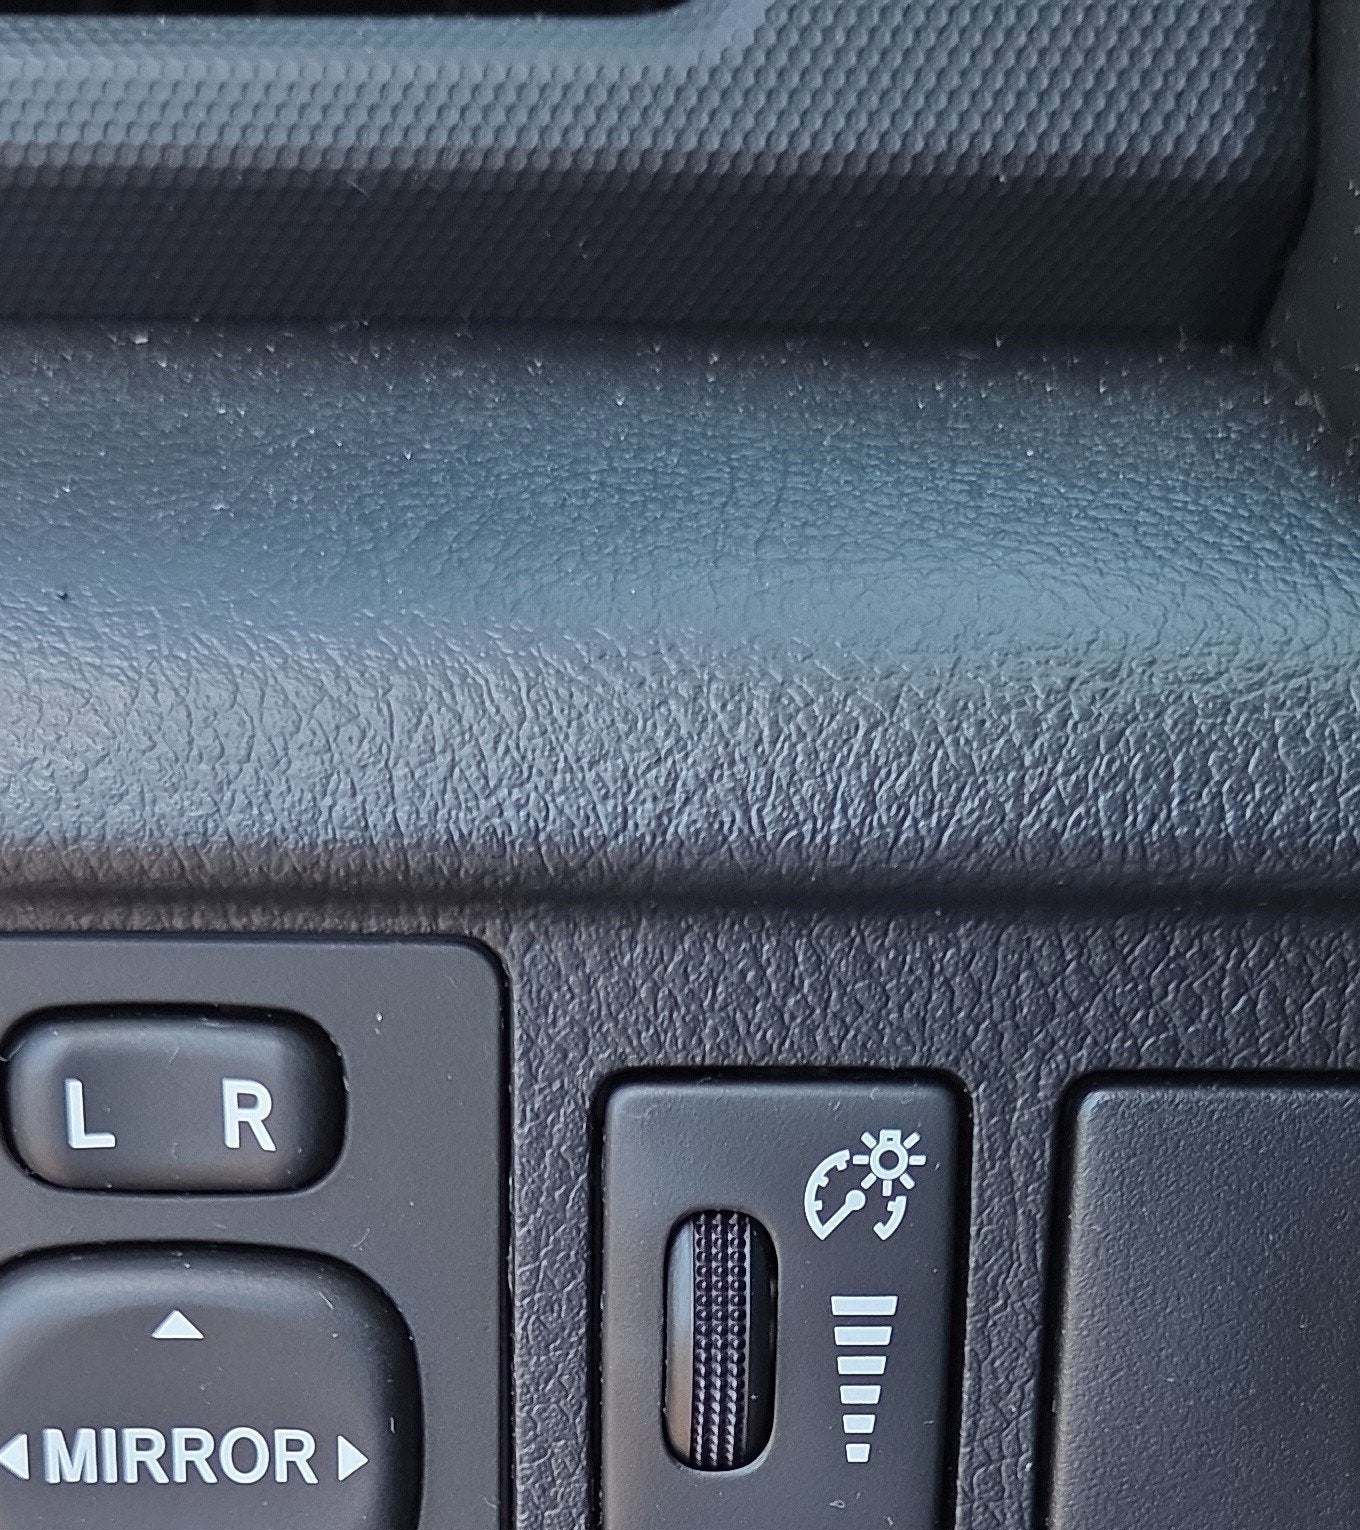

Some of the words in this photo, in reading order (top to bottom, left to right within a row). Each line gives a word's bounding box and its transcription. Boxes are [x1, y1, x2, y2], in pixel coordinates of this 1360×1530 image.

[65, 1078, 115, 1149] L
[221, 1078, 276, 1152] R
[44, 1427, 319, 1485] MIRROR
